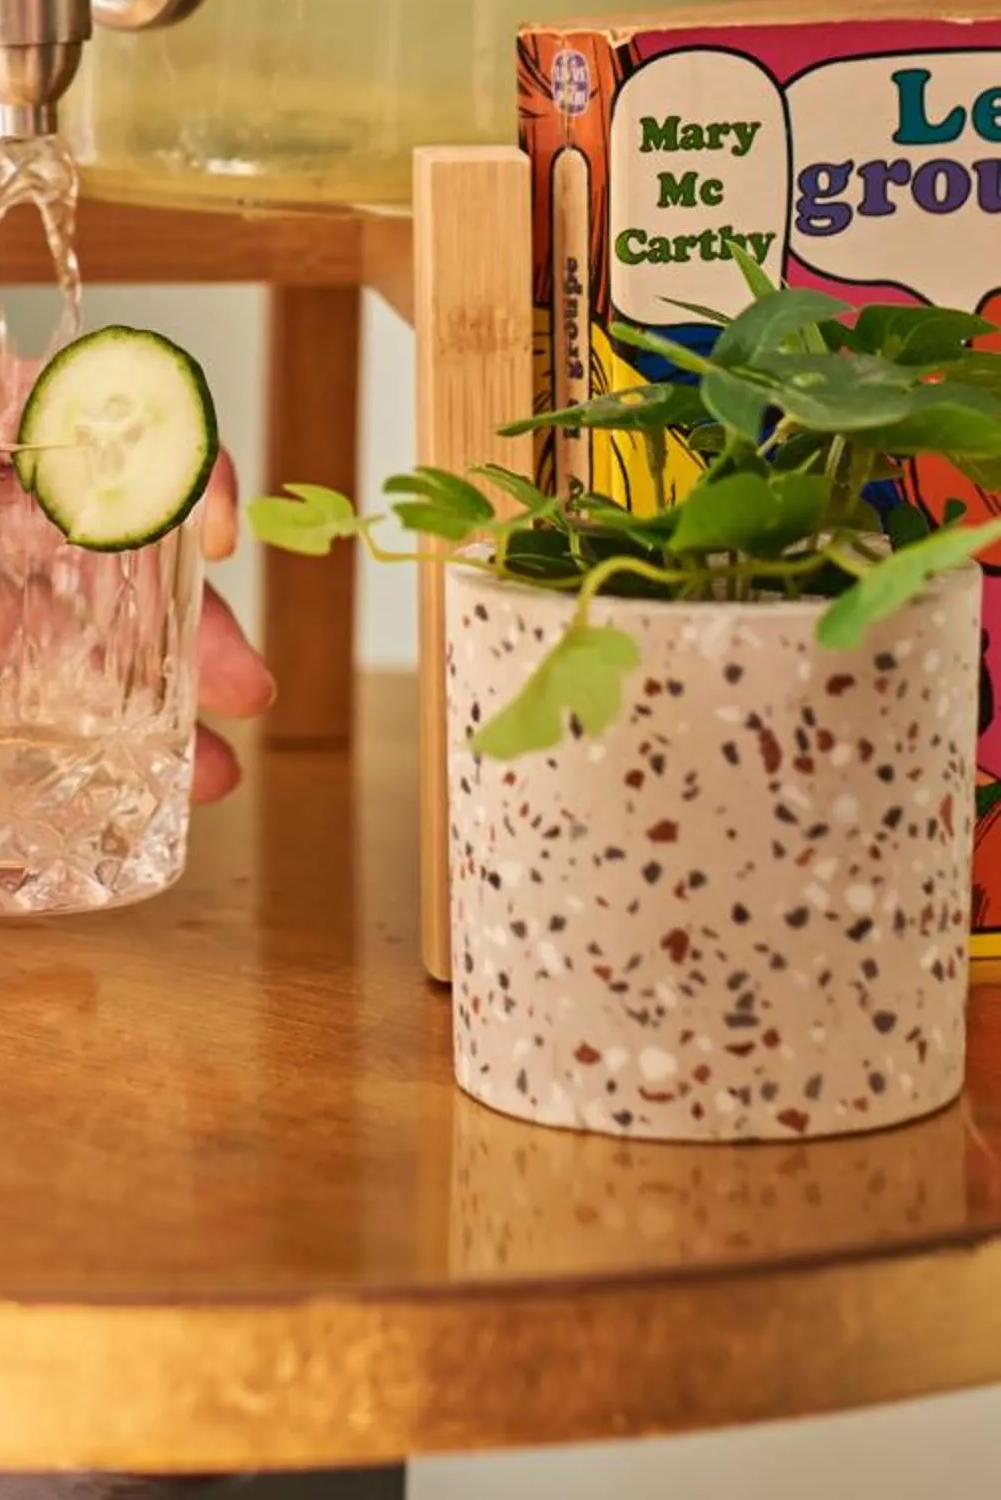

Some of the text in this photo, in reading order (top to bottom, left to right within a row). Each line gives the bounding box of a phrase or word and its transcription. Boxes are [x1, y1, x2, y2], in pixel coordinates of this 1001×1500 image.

[891, 68, 1001, 145] Le
[639, 116, 762, 156] Mary
[657, 171, 724, 208] Mc
[615, 225, 776, 267] Carthy
